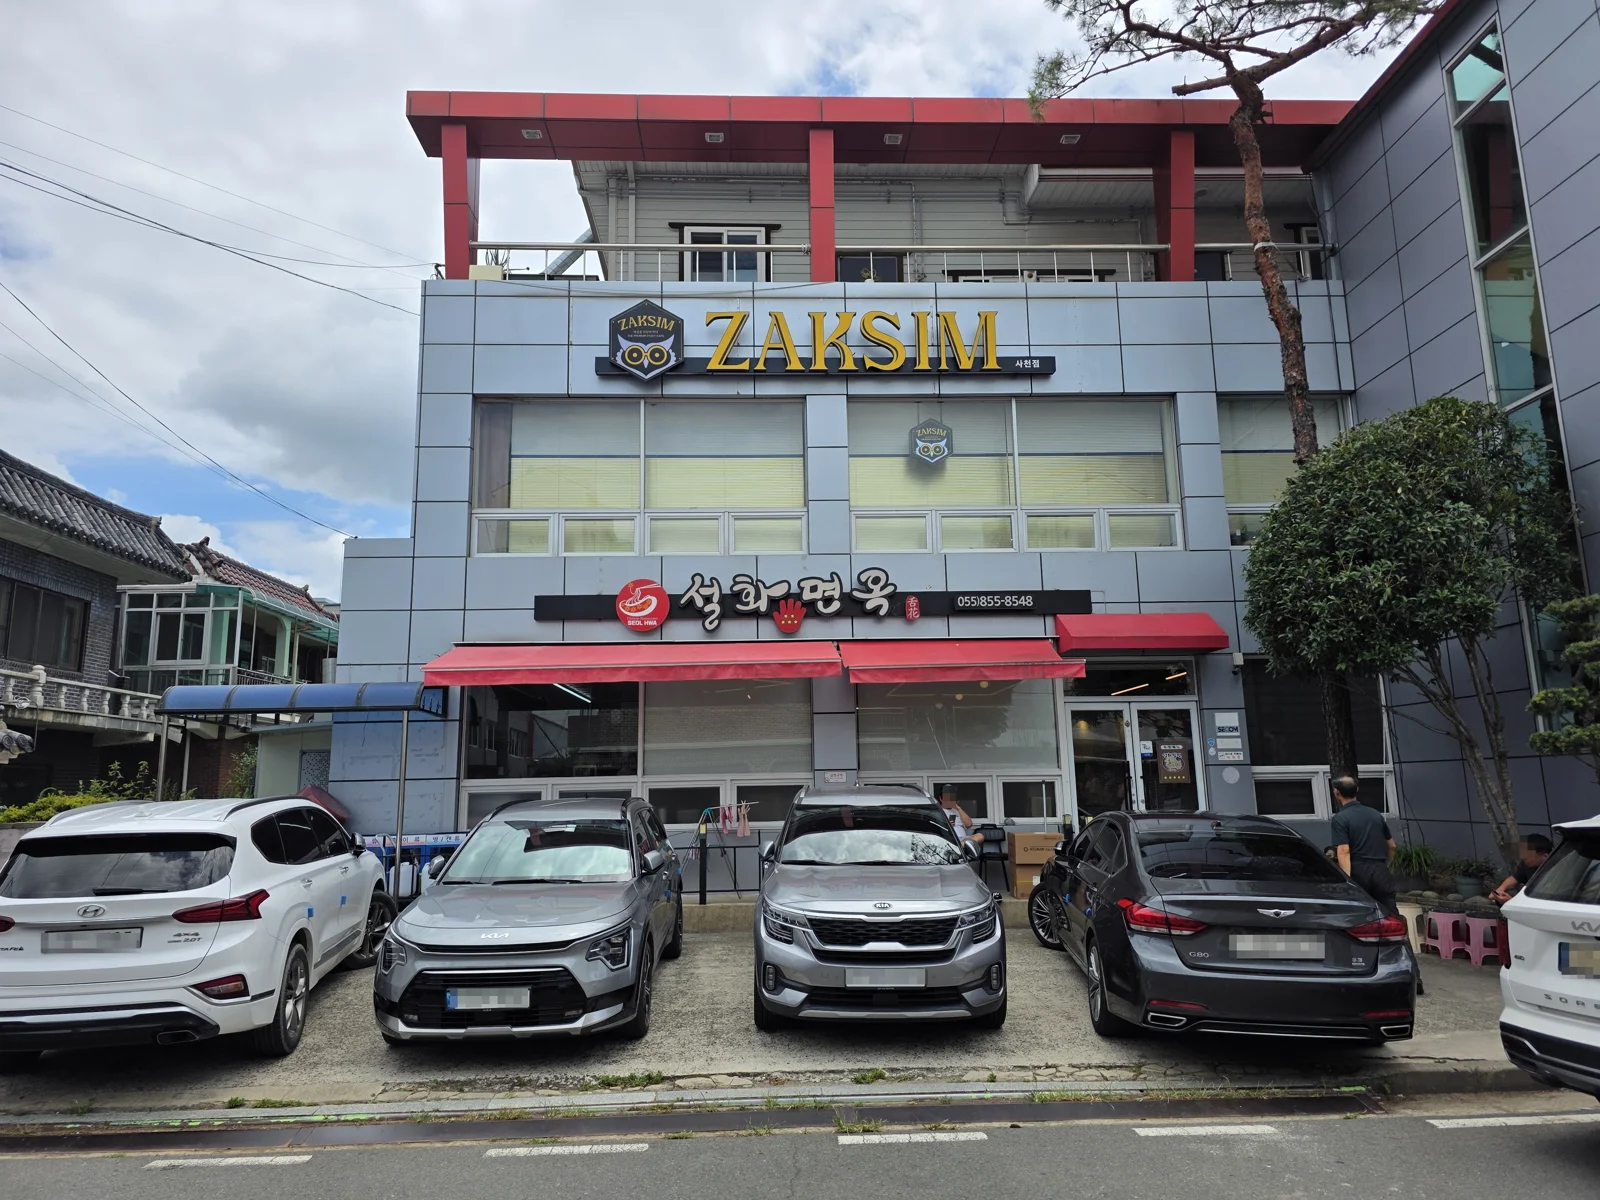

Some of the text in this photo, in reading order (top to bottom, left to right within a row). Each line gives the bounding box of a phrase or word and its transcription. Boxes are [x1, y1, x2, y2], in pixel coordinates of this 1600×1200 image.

[617, 315, 676, 332] ZAKSIM
[705, 310, 1002, 372] ZAKSIM
[1015, 359, 1040, 369] 사천점
[915, 427, 947, 437] ZAKSIM
[677, 566, 898, 633] 설화면옥
[957, 595, 1034, 607] 055)855-8548
[1188, 951, 1210, 959] G80
